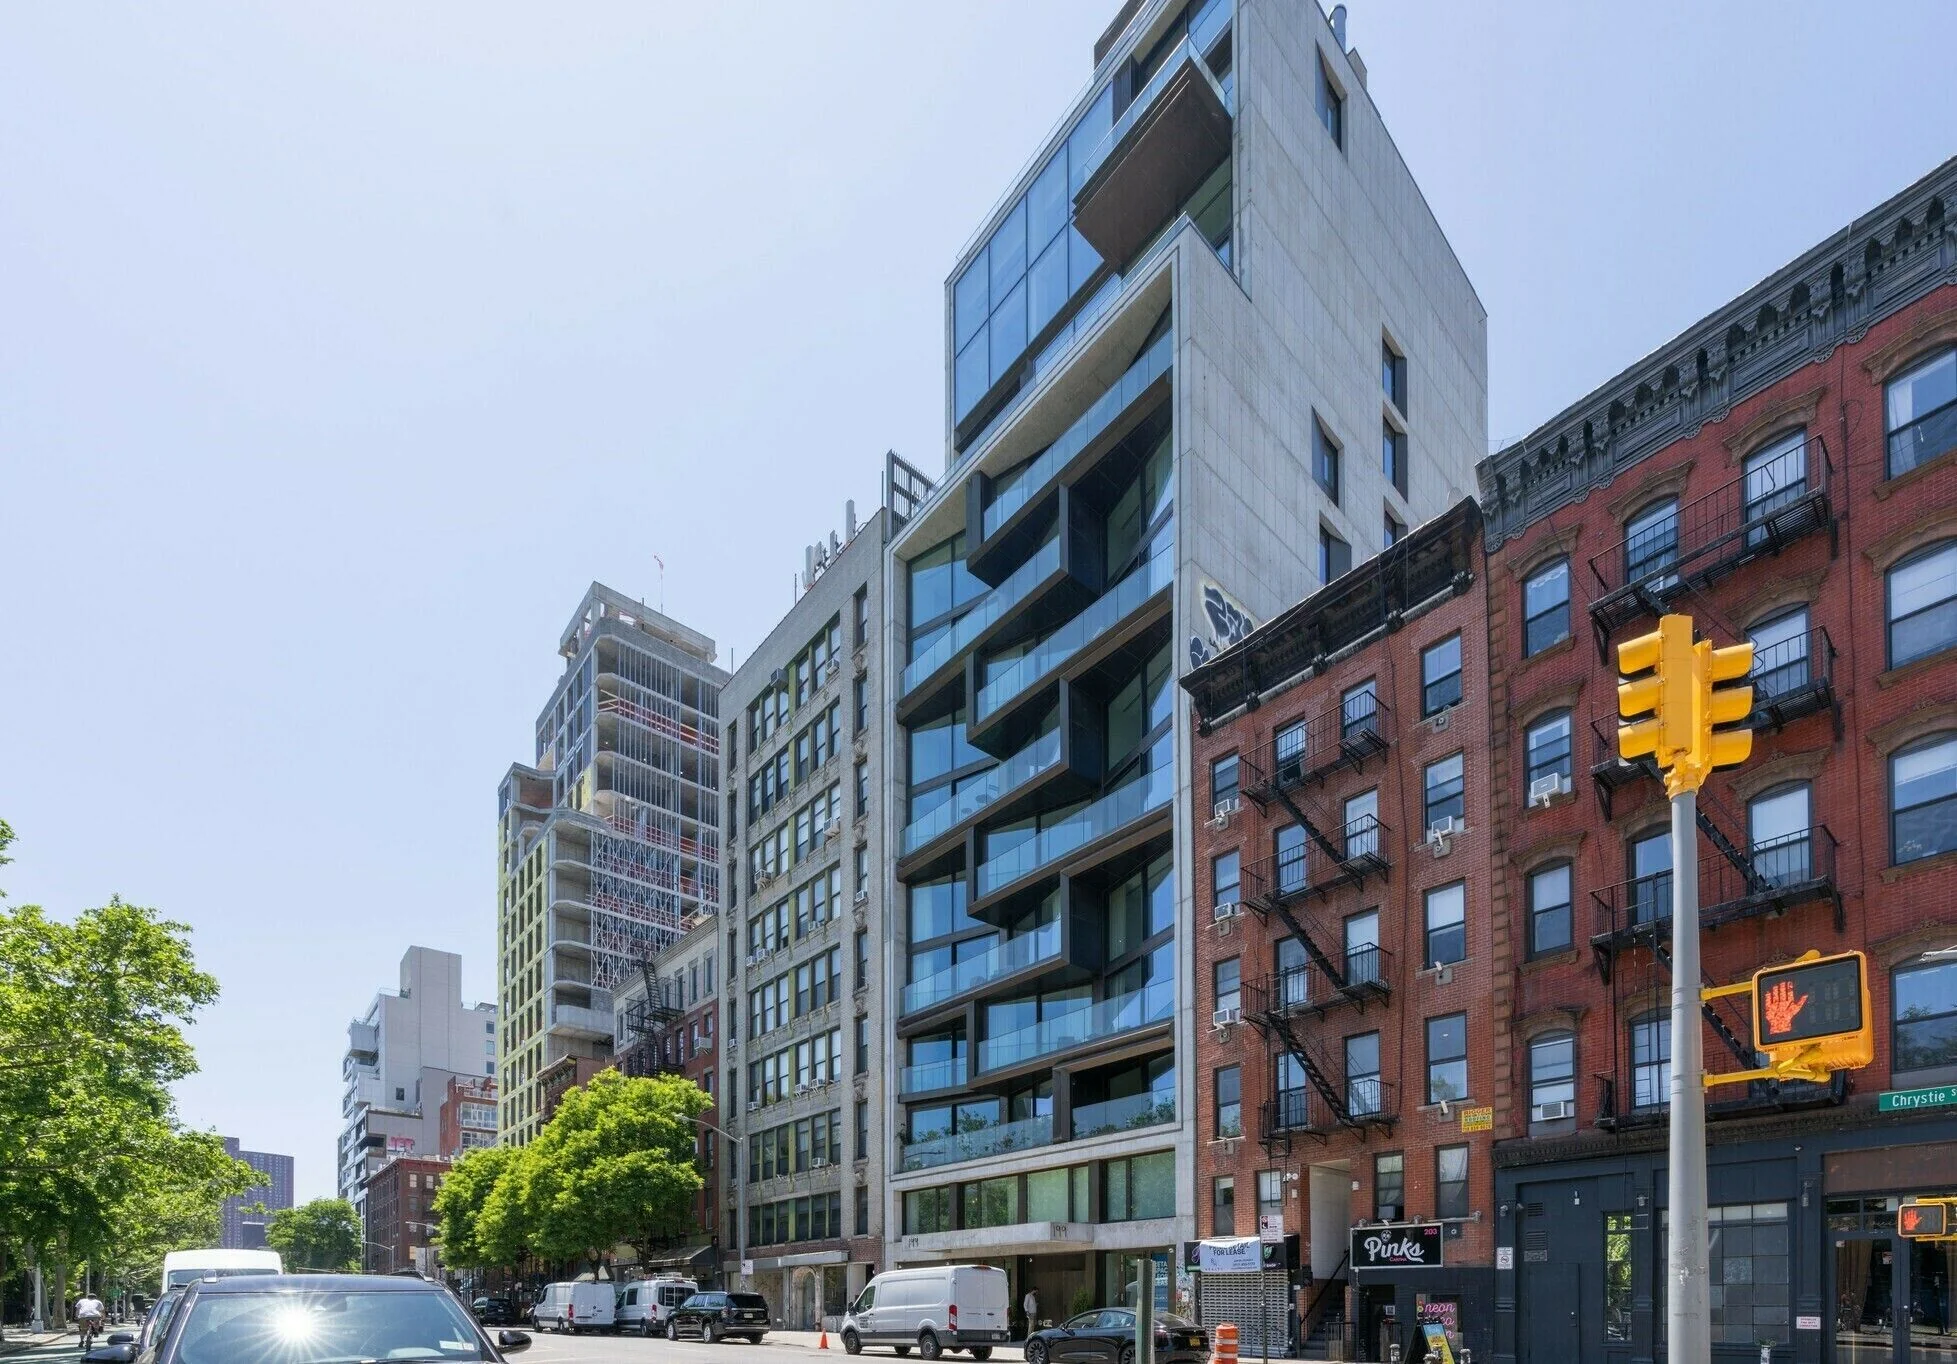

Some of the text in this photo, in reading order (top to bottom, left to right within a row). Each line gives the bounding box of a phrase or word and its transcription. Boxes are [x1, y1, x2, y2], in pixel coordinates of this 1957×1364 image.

[1892, 1091, 1945, 1107] Chrystie
[1053, 1226, 1067, 1238] 199
[1364, 1236, 1425, 1263] Pinks
[1424, 1303, 1456, 1313] neon
